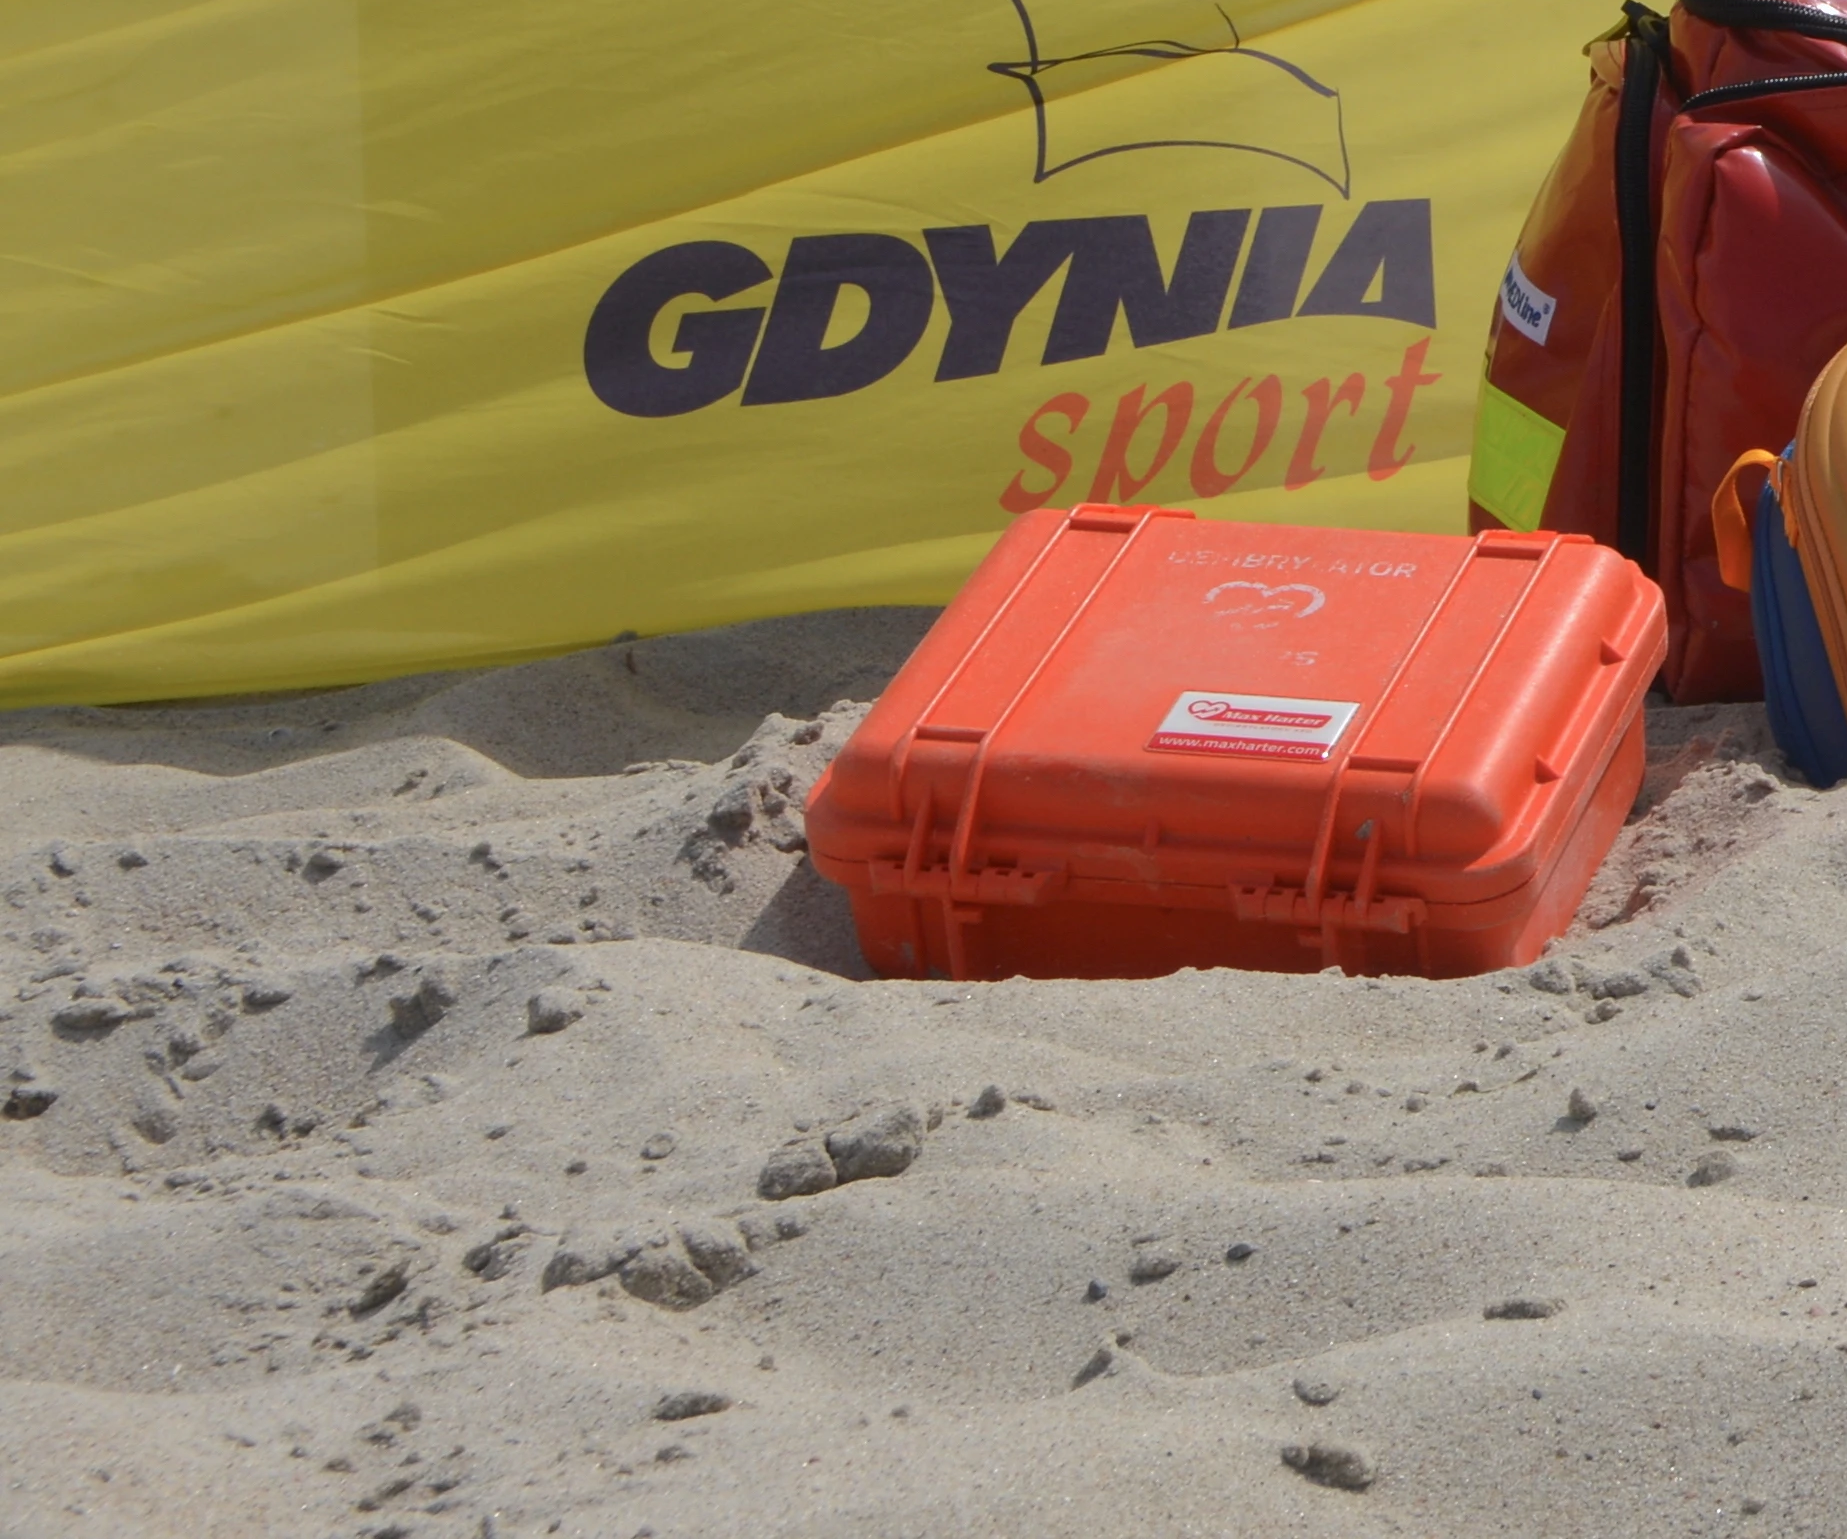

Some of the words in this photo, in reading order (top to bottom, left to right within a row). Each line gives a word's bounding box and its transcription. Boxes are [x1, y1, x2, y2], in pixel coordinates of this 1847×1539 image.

[583, 198, 1437, 419] GDYNIA
[998, 336, 1443, 515] sport
[1158, 735, 1321, 756] www.maxharter.com
[1222, 710, 1263, 722] Max
[1263, 713, 1325, 726] Harter
